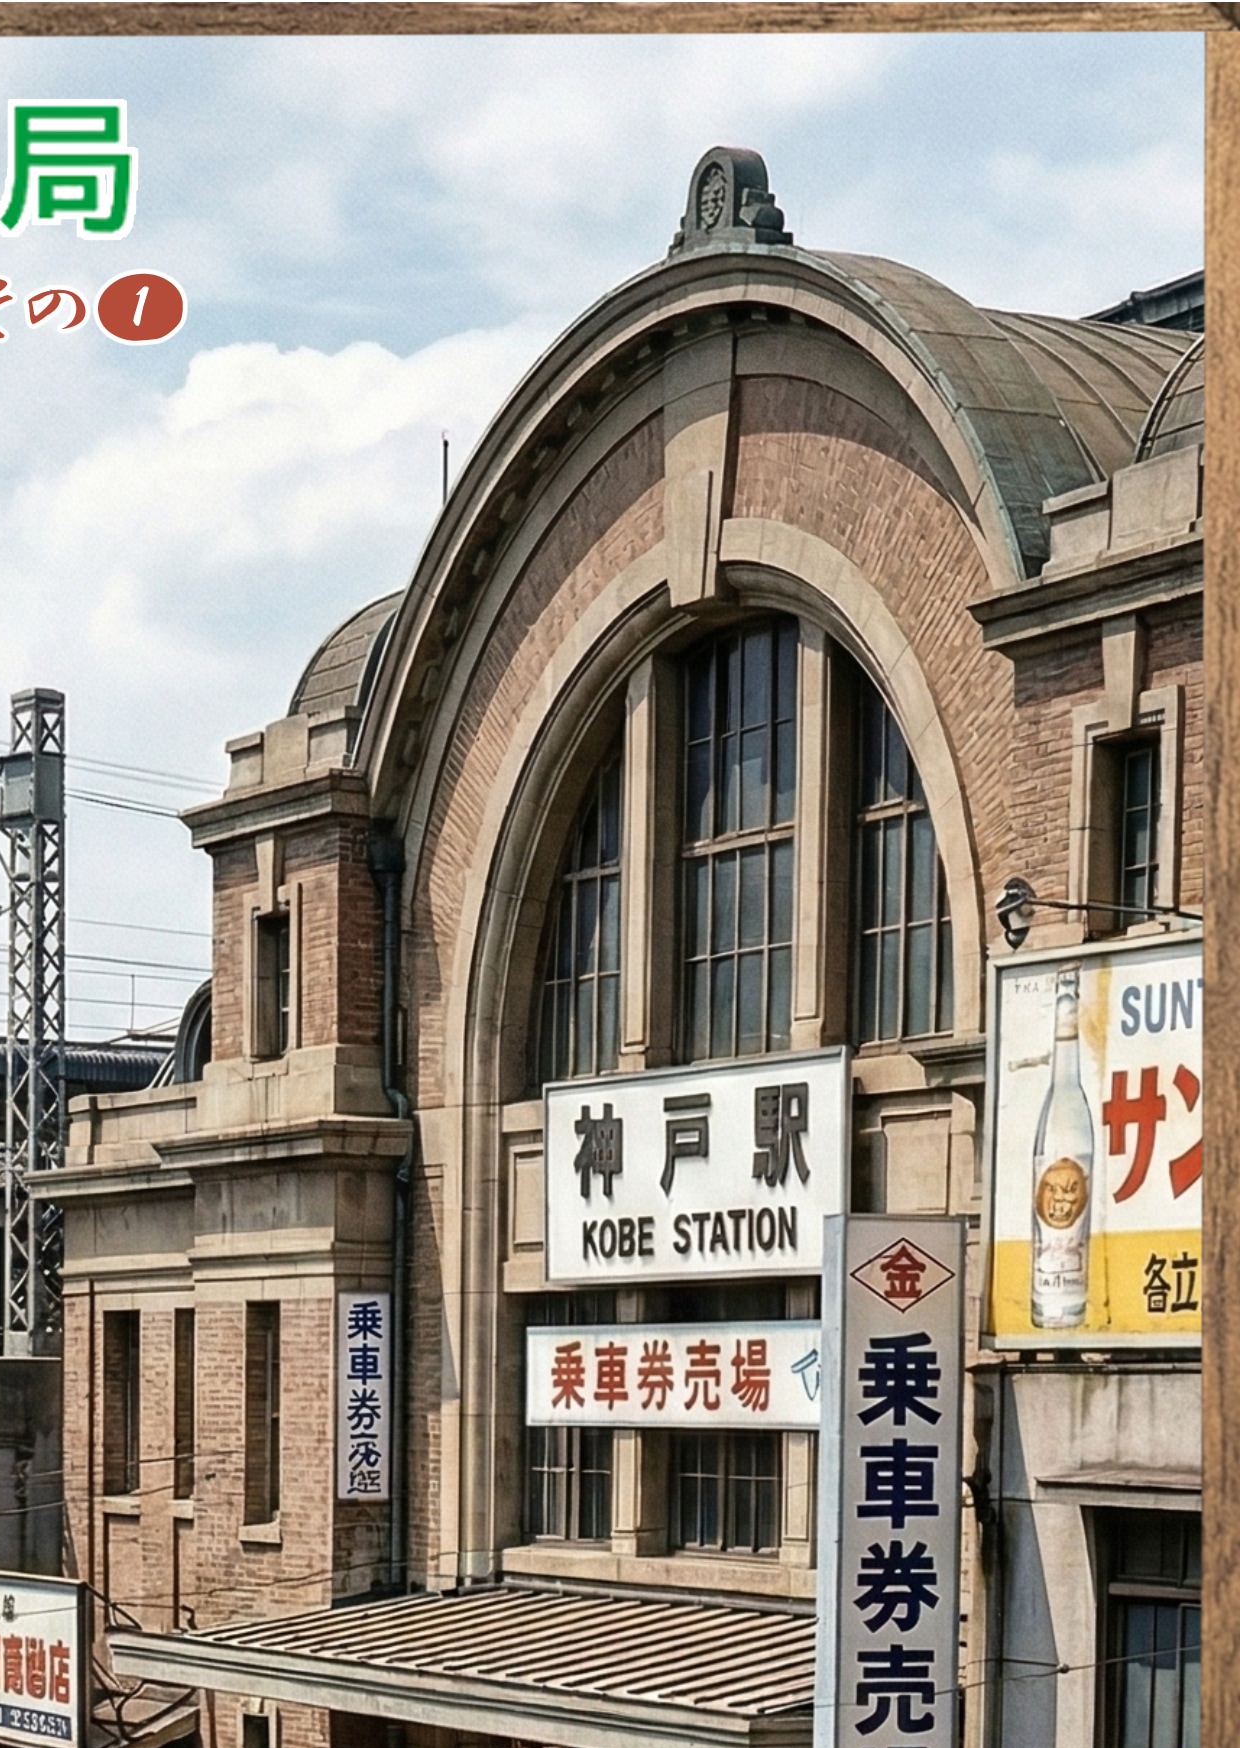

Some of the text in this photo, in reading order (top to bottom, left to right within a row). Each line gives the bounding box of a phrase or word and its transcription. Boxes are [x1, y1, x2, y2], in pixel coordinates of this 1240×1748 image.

[1121, 978, 1203, 1036] SUN
[573, 1081, 812, 1200] 神戸駅
[582, 1206, 798, 1260] KOBE STATION
[879, 1244, 927, 1301] 金
[550, 1338, 772, 1412] 乗車券売場
